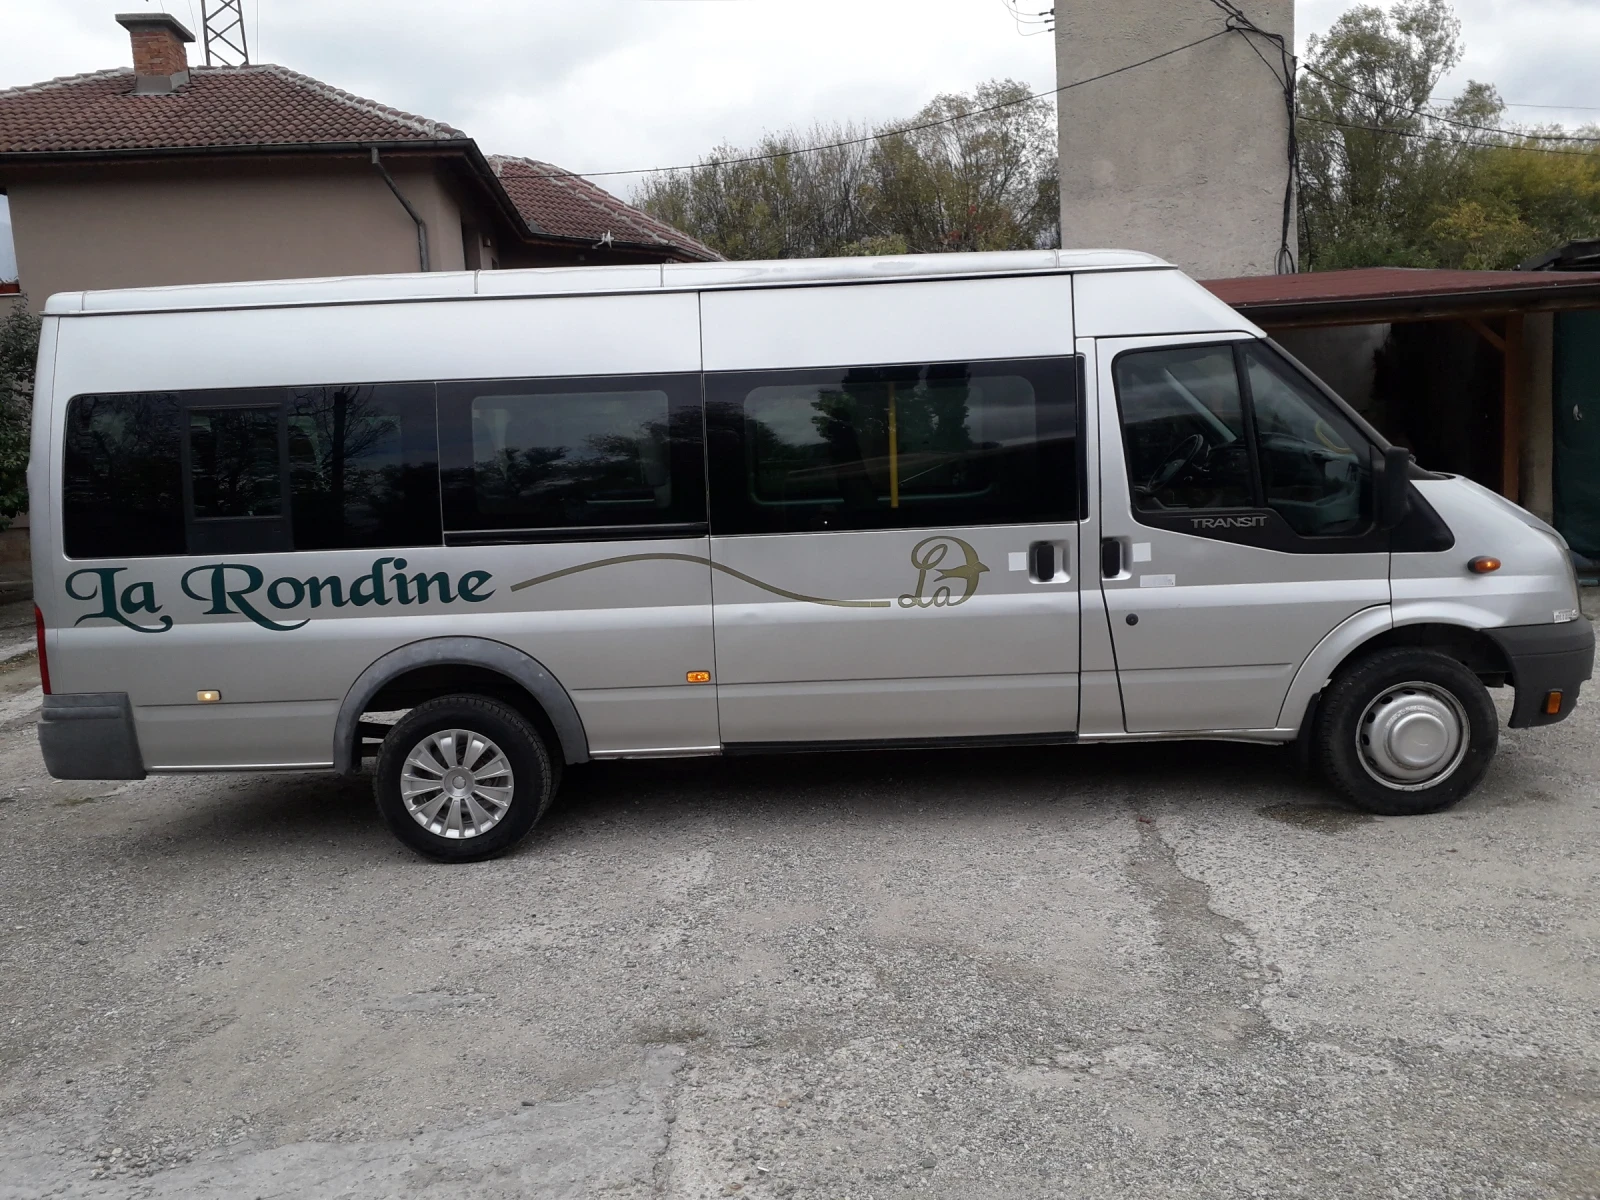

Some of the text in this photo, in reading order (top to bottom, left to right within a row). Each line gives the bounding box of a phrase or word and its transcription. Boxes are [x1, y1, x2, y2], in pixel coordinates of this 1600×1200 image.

[1191, 516, 1267, 529] TRANSIT
[65, 556, 496, 633] La Rondine
